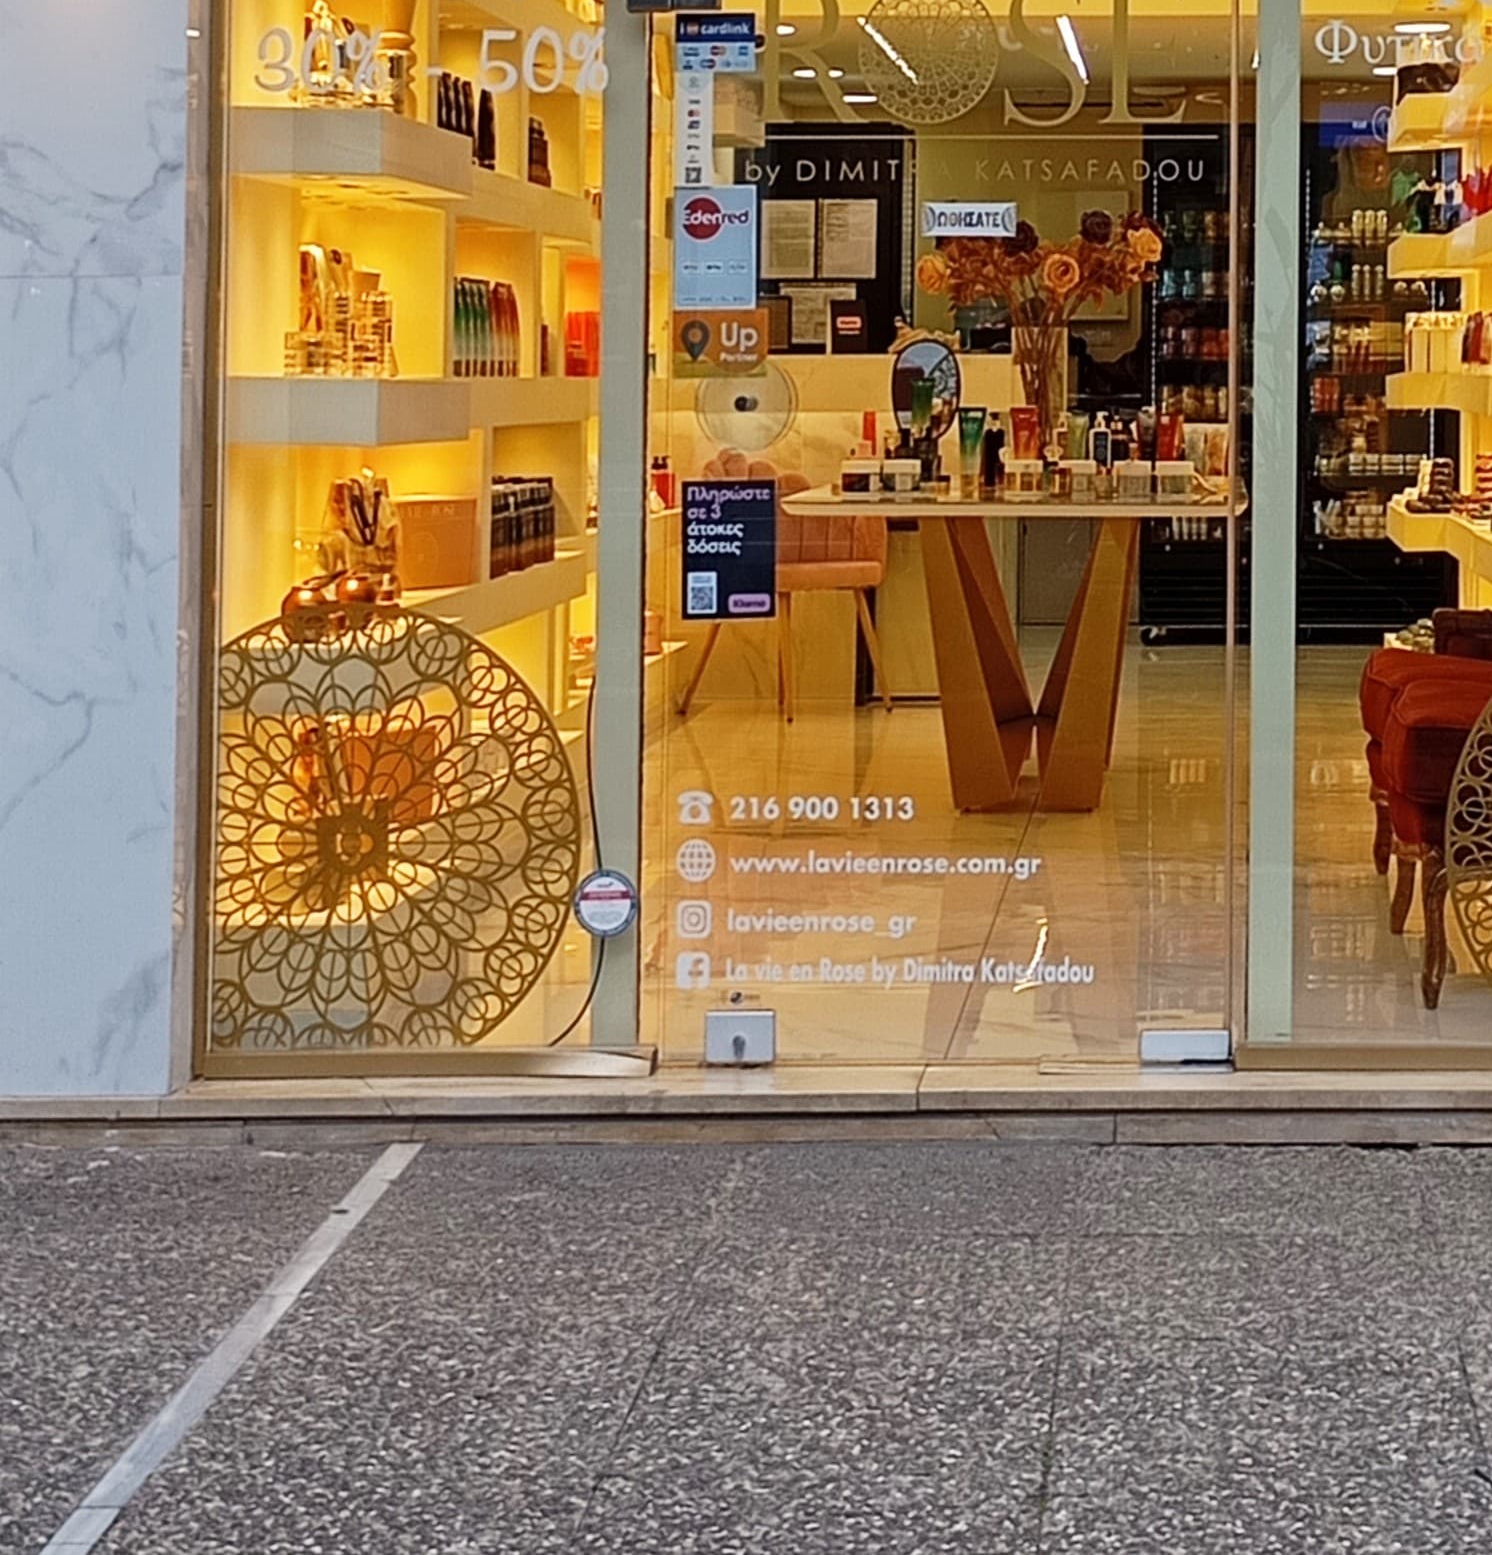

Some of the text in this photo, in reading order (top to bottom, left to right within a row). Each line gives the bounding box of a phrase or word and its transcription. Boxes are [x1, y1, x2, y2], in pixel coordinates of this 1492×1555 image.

[701, 22, 751, 35] cardlink
[254, 25, 389, 94] 30%
[480, 25, 608, 94] 50%
[744, 159, 781, 186] by
[976, 159, 1205, 183] KATSAFADOU
[683, 209, 750, 225] Edenred
[720, 321, 759, 353] Up
[687, 485, 771, 504] Πληρώστε
[687, 503, 722, 520] σε 3
[686, 521, 744, 537] άτοκες
[686, 539, 742, 556] δόσεις
[730, 796, 914, 821] 216 900 1313
[730, 850, 1042, 880] www.lavieenrose.com.gr
[727, 909, 917, 939] lavieenrose_gr
[726, 959, 748, 983] La
[753, 960, 784, 983] vie
[789, 964, 814, 983] en
[819, 959, 866, 983] Rose
[871, 959, 897, 989] by
[903, 957, 974, 983] Dimitra
